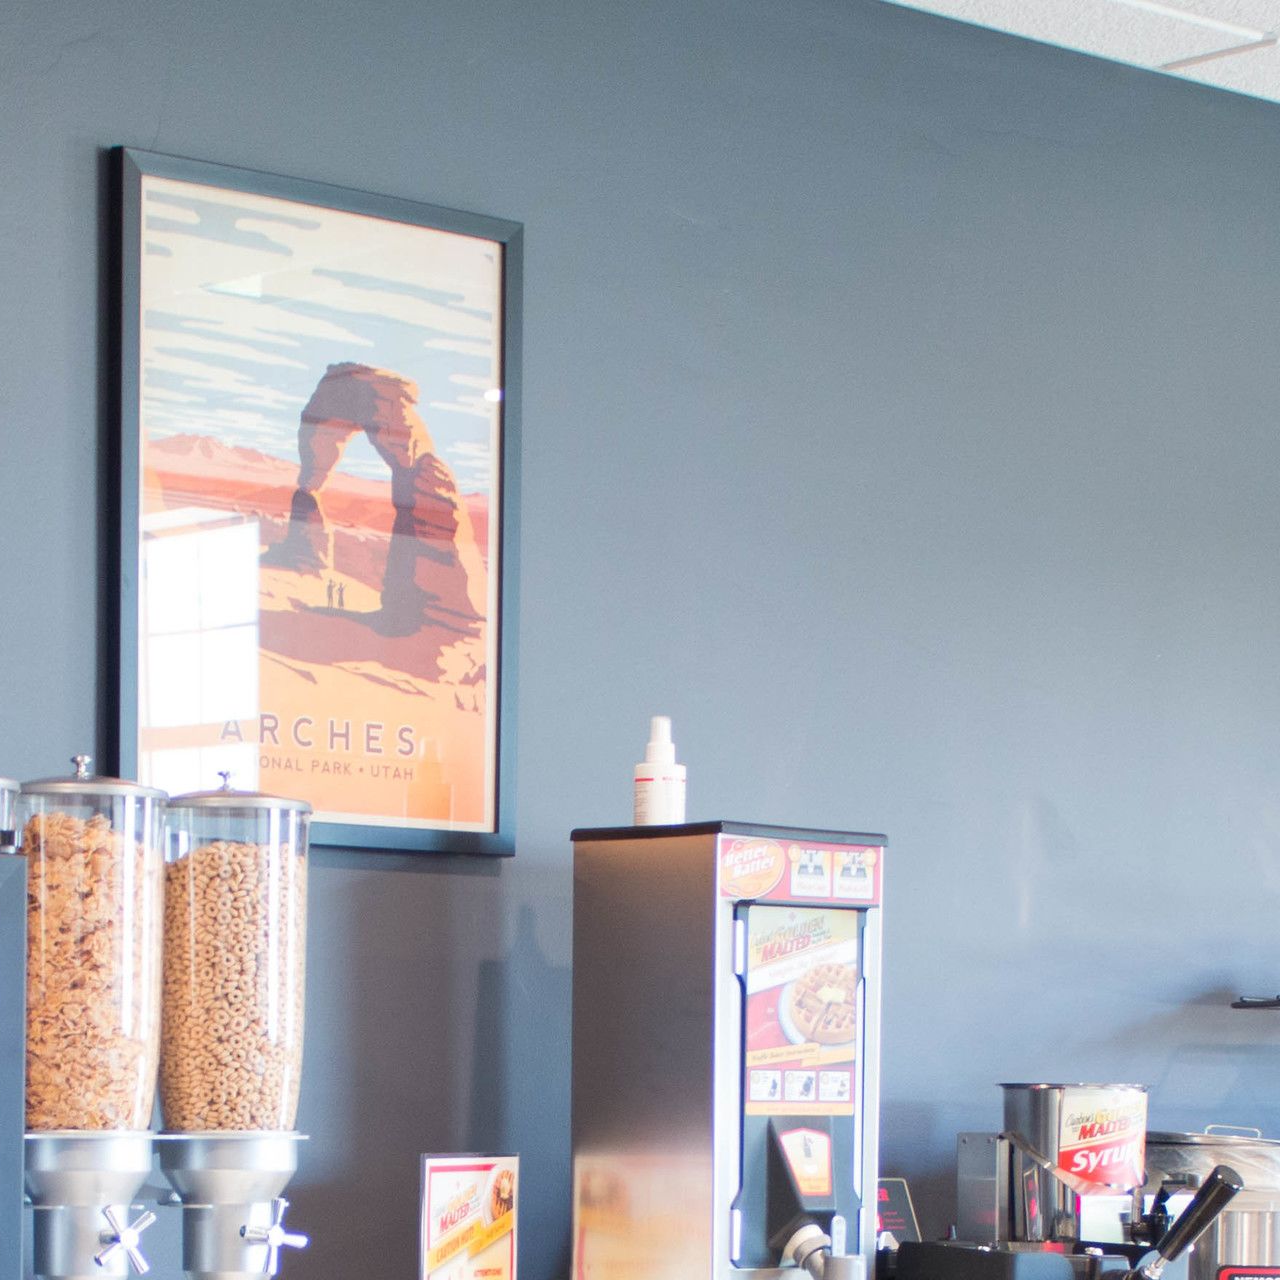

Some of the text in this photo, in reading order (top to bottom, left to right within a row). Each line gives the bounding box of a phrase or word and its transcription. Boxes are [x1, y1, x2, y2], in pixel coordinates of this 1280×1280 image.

[221, 713, 415, 756] ARCHES
[311, 759, 353, 776] PARK
[370, 765, 414, 781] UTAH
